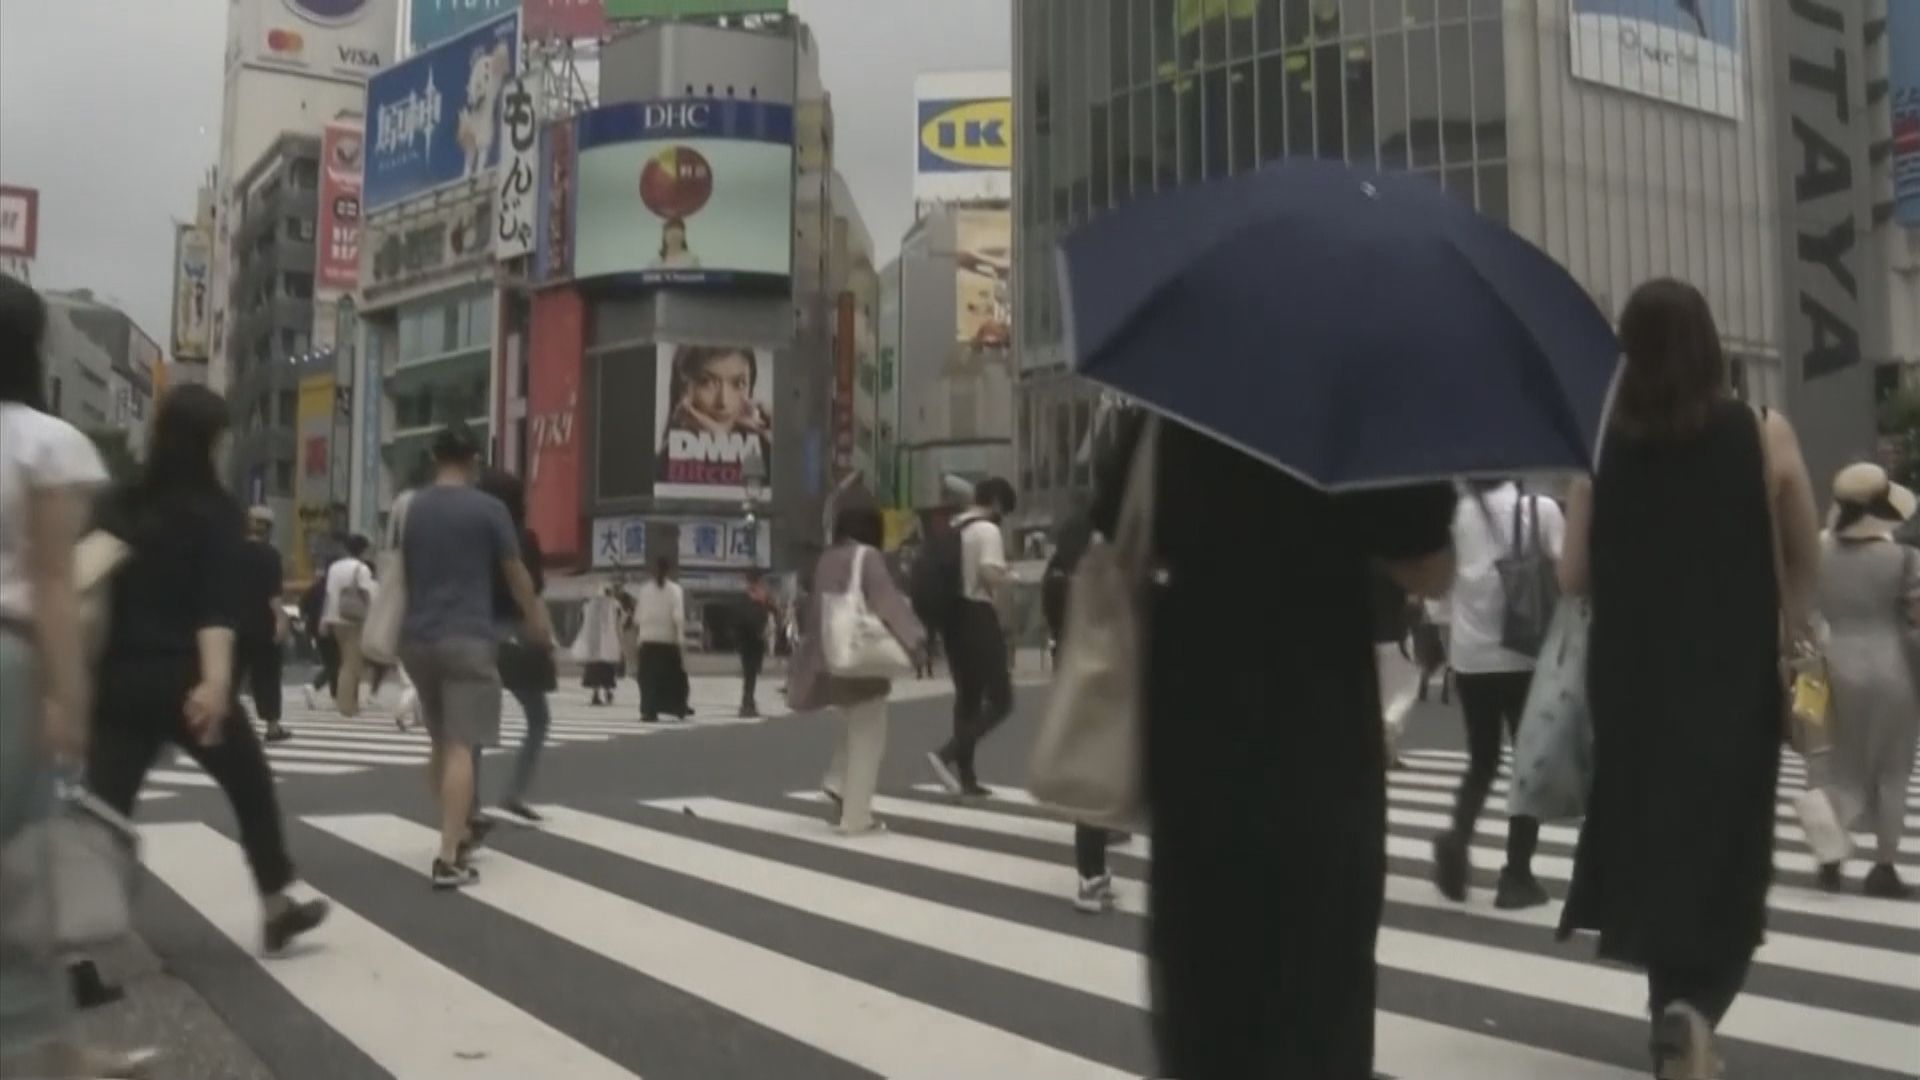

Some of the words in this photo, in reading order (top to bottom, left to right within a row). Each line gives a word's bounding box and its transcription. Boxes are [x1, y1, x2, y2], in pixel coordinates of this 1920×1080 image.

[338, 45, 380, 66] VISA
[644, 103, 710, 129] DHC
[499, 82, 536, 248] もんじゃ
[669, 429, 762, 462] DMM
